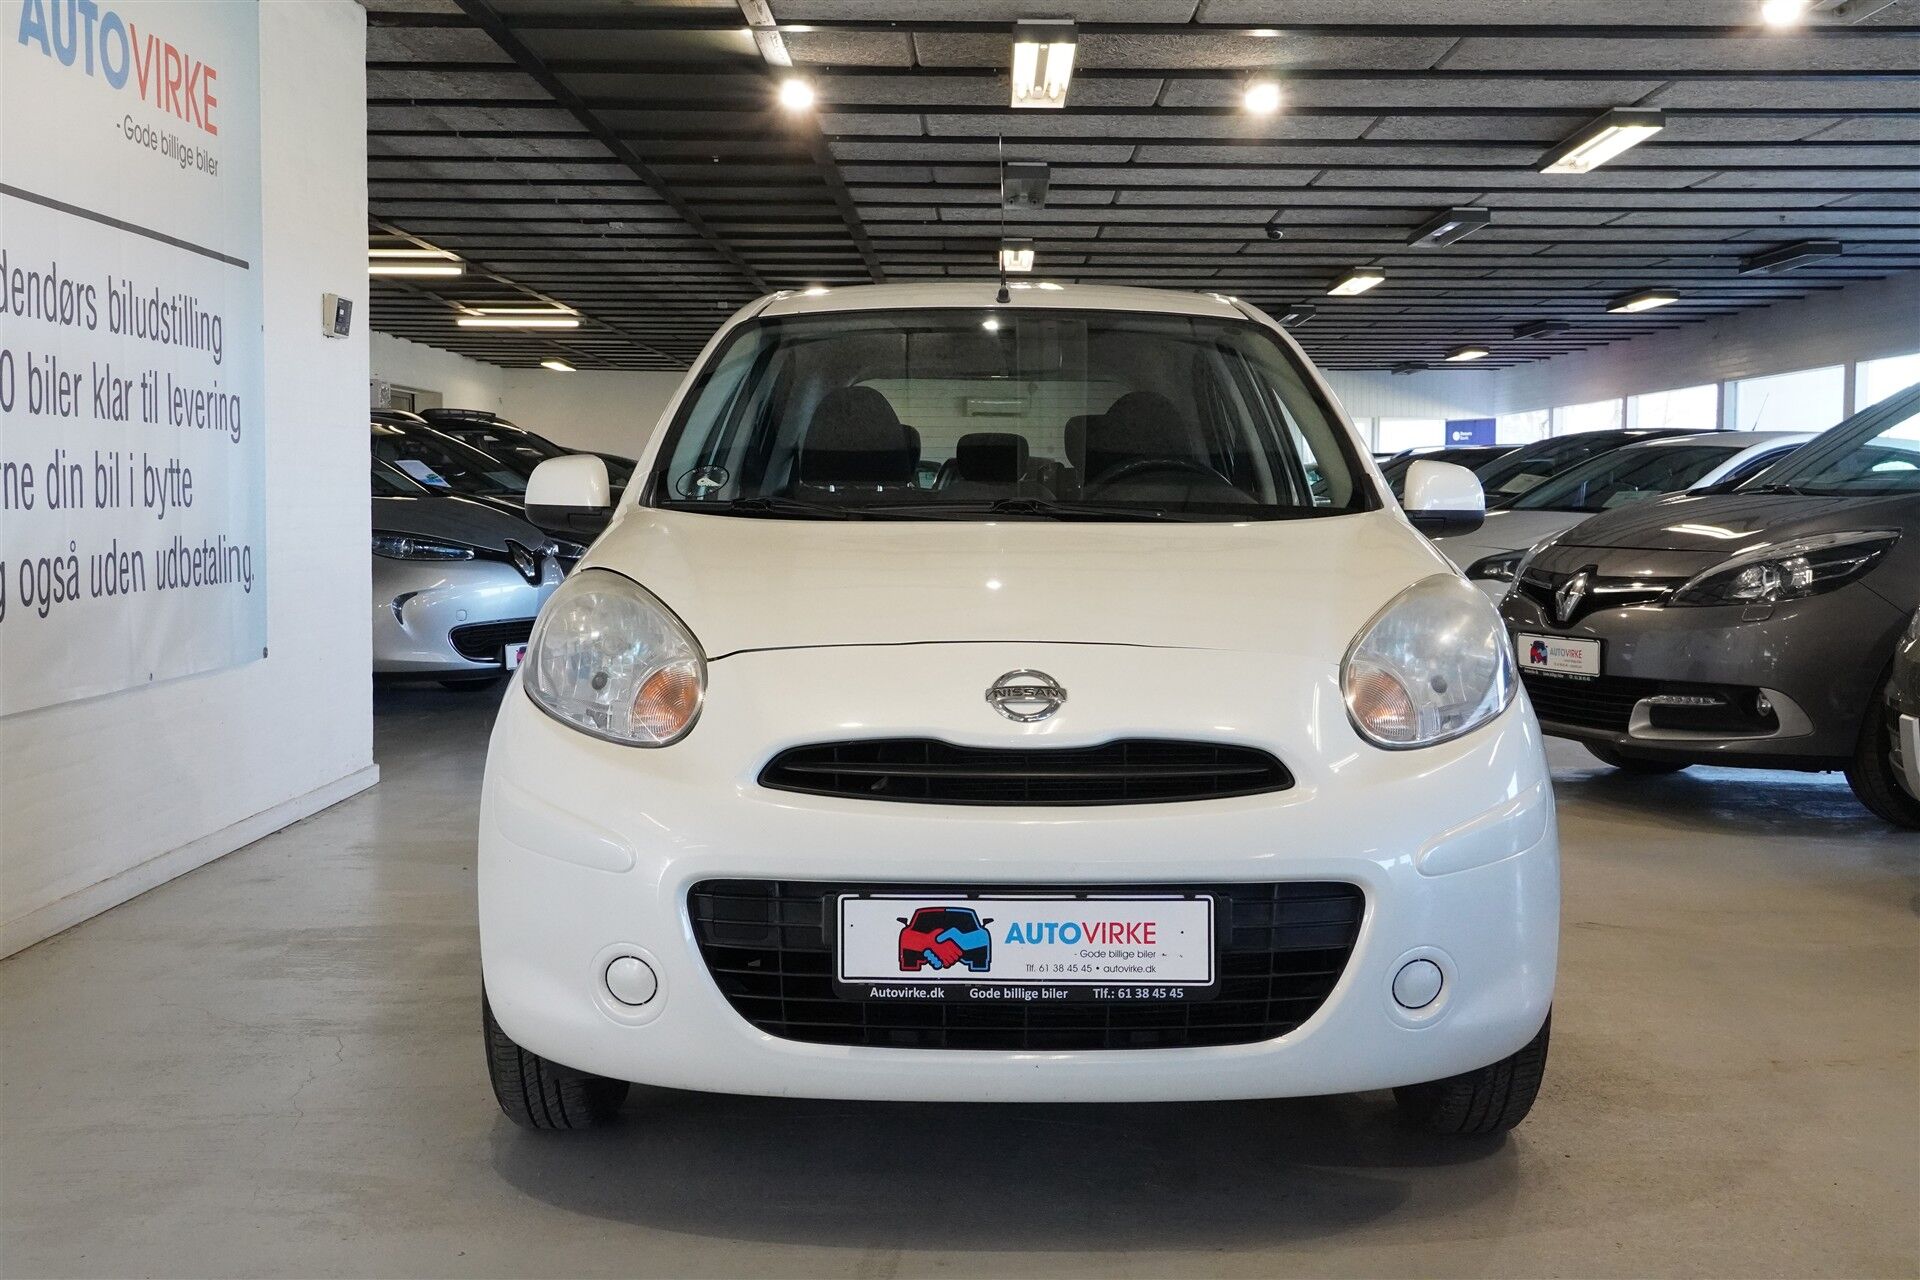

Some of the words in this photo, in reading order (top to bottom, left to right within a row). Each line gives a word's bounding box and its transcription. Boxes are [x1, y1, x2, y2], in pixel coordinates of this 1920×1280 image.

[18, 0, 218, 136] AUTOVIRKE
[124, 114, 158, 151] Gode
[160, 129, 194, 169] billige
[196, 146, 218, 176] biler
[108, 274, 222, 365] biludstilling
[28, 351, 82, 418] biler
[93, 361, 133, 421] klar
[141, 369, 158, 424] til
[168, 372, 241, 444] levering
[0, 461, 34, 510] ne
[46, 448, 84, 509] din
[95, 450, 120, 509] bil
[130, 452, 134, 507] i
[144, 452, 193, 520] bytte
[19, 540, 80, 618] også
[91, 538, 146, 598] uden
[156, 534, 255, 593] udbetaling.
[1549, 647, 1583, 659] AUTOVIRKE
[993, 687, 1059, 698] NISSAN
[1004, 922, 1156, 945] AUTOVIRKE
[1080, 949, 1106, 958] Gode
[1108, 949, 1134, 960] billige
[1137, 949, 1156, 958] biler
[1026, 964, 1036, 973] Tlf.
[1038, 964, 1049, 973] 61
[1052, 964, 1064, 973] 38
[1066, 964, 1078, 973] 45
[1081, 964, 1093, 973] 45
[1103, 963, 1157, 973] autovirke.dk
[869, 987, 945, 998] Autovirke.dk
[969, 988, 1000, 999] Gode
[1003, 987, 1039, 1001] billige
[1041, 988, 1068, 999] biler
[1093, 988, 1115, 999] Tlf.:
[1117, 988, 1131, 999] 61
[1135, 988, 1149, 999] 38
[1152, 988, 1166, 999] 45
[1169, 988, 1184, 999] 45
